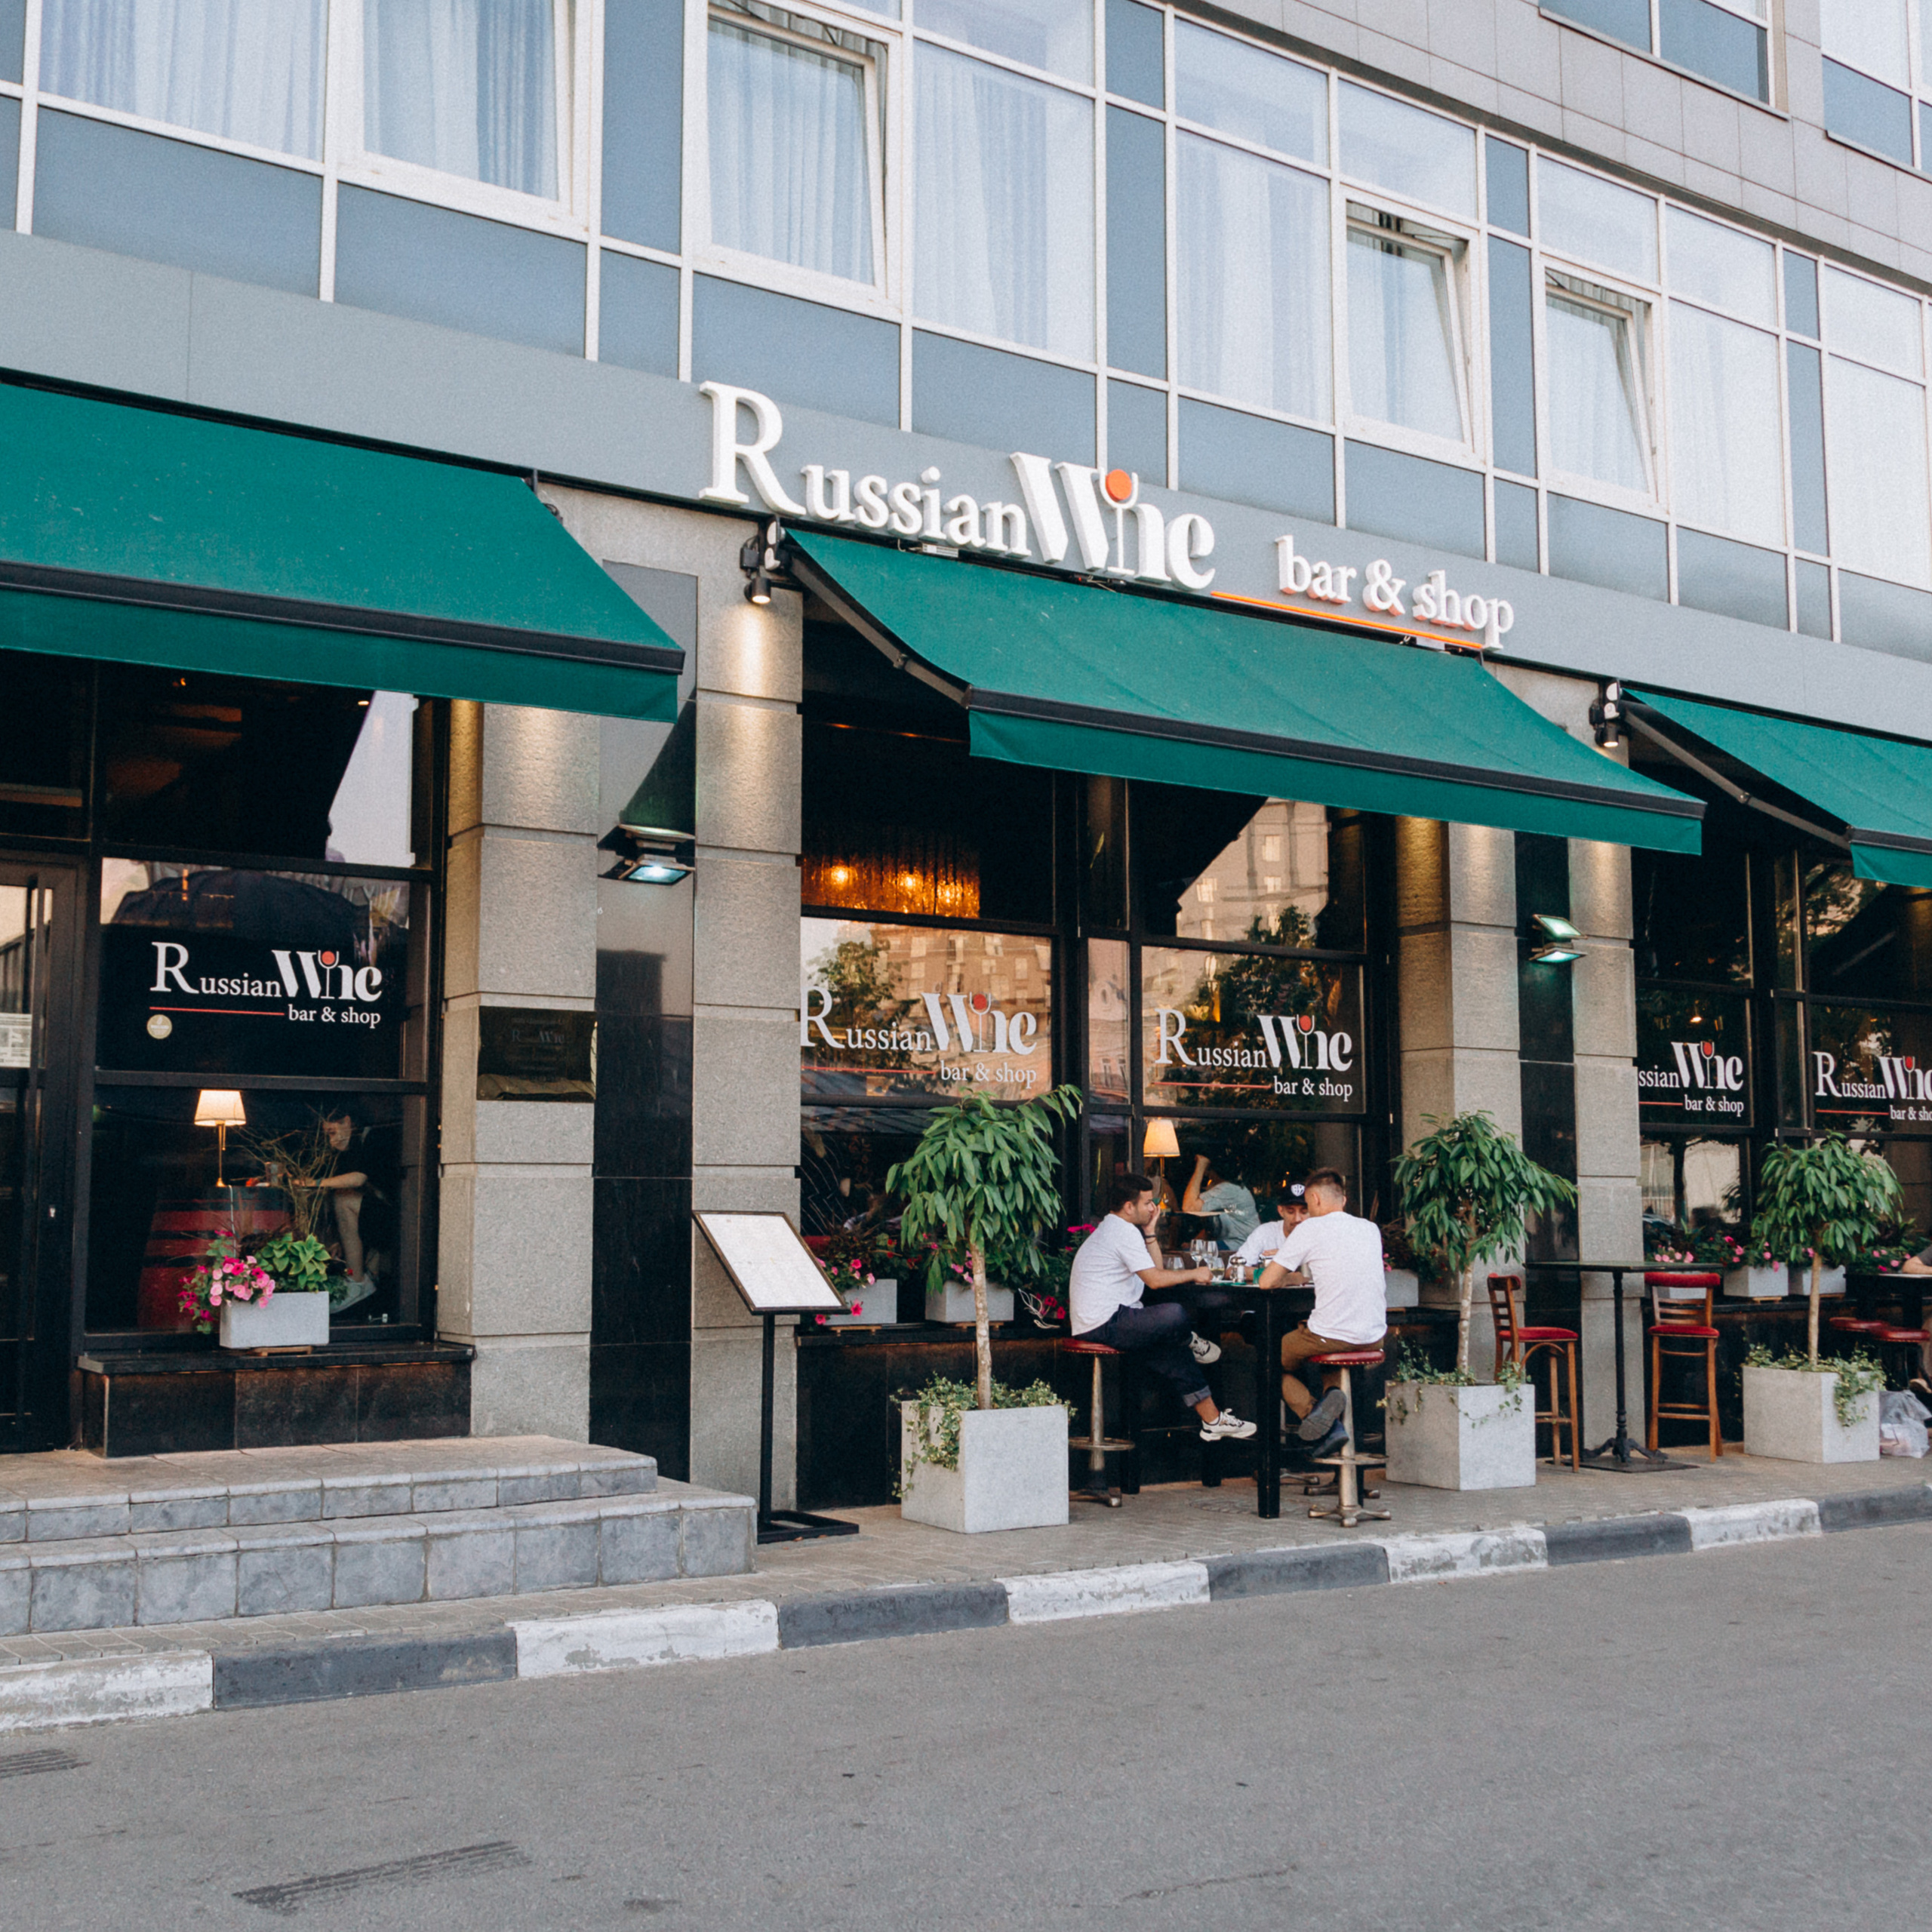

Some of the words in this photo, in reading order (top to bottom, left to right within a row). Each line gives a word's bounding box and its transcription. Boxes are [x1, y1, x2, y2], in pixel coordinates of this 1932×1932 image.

[1275, 534, 1356, 605] bar
[1363, 559, 1406, 617] &
[1413, 570, 1514, 652] shop
[288, 1004, 317, 1021] bar
[321, 1006, 337, 1023] &
[341, 1006, 380, 1029] shop
[940, 1060, 970, 1081] bar
[975, 1063, 989, 1081] &
[996, 1063, 1036, 1089] shop
[1638, 1065, 1680, 1088] ssian
[1274, 1075, 1298, 1094] bar
[1302, 1078, 1315, 1095] &
[1318, 1078, 1352, 1102] shop
[1684, 1094, 1703, 1111] bar
[1706, 1096, 1715, 1111] &
[1718, 1096, 1744, 1117] shop
[1890, 1104, 1906, 1120] bar
[1908, 1106, 1916, 1120] &
